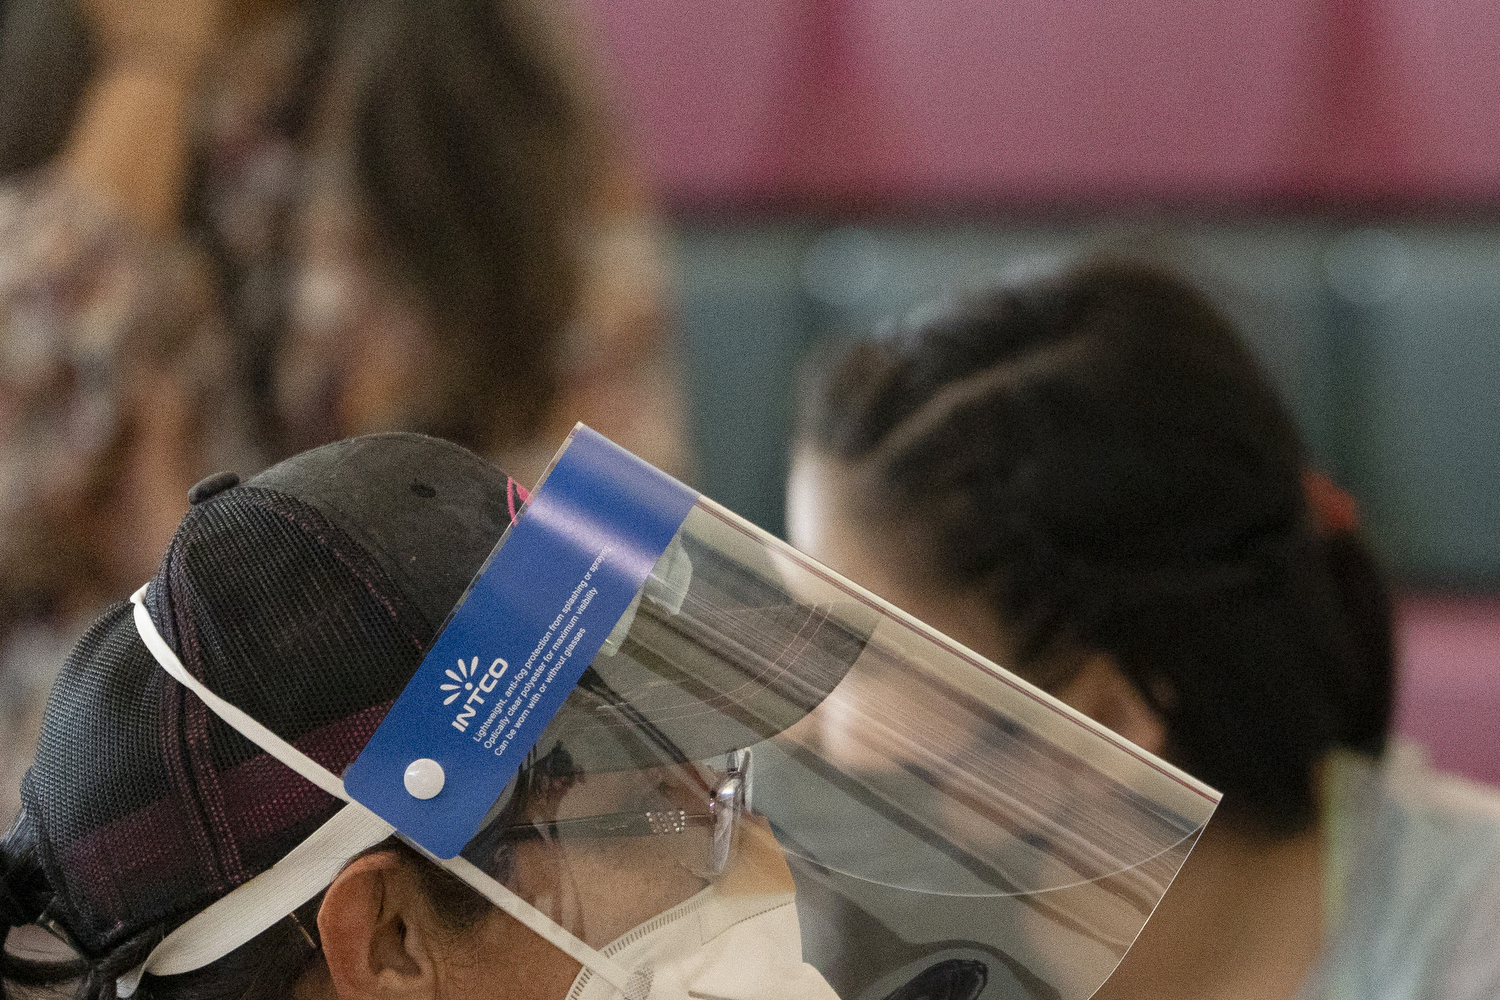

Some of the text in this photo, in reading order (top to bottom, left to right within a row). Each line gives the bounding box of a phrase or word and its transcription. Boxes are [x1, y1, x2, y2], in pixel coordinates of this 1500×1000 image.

[451, 657, 509, 733] INTCO
[483, 587, 599, 749] Optically clear polyester for maximum visibility
[494, 627, 586, 757] Can be worn with or without glasses
[504, 668, 529, 698] anti-fog
[524, 631, 553, 670] protection
[548, 613, 565, 632] from
[561, 579, 589, 614] splashing
[583, 571, 593, 582] or
